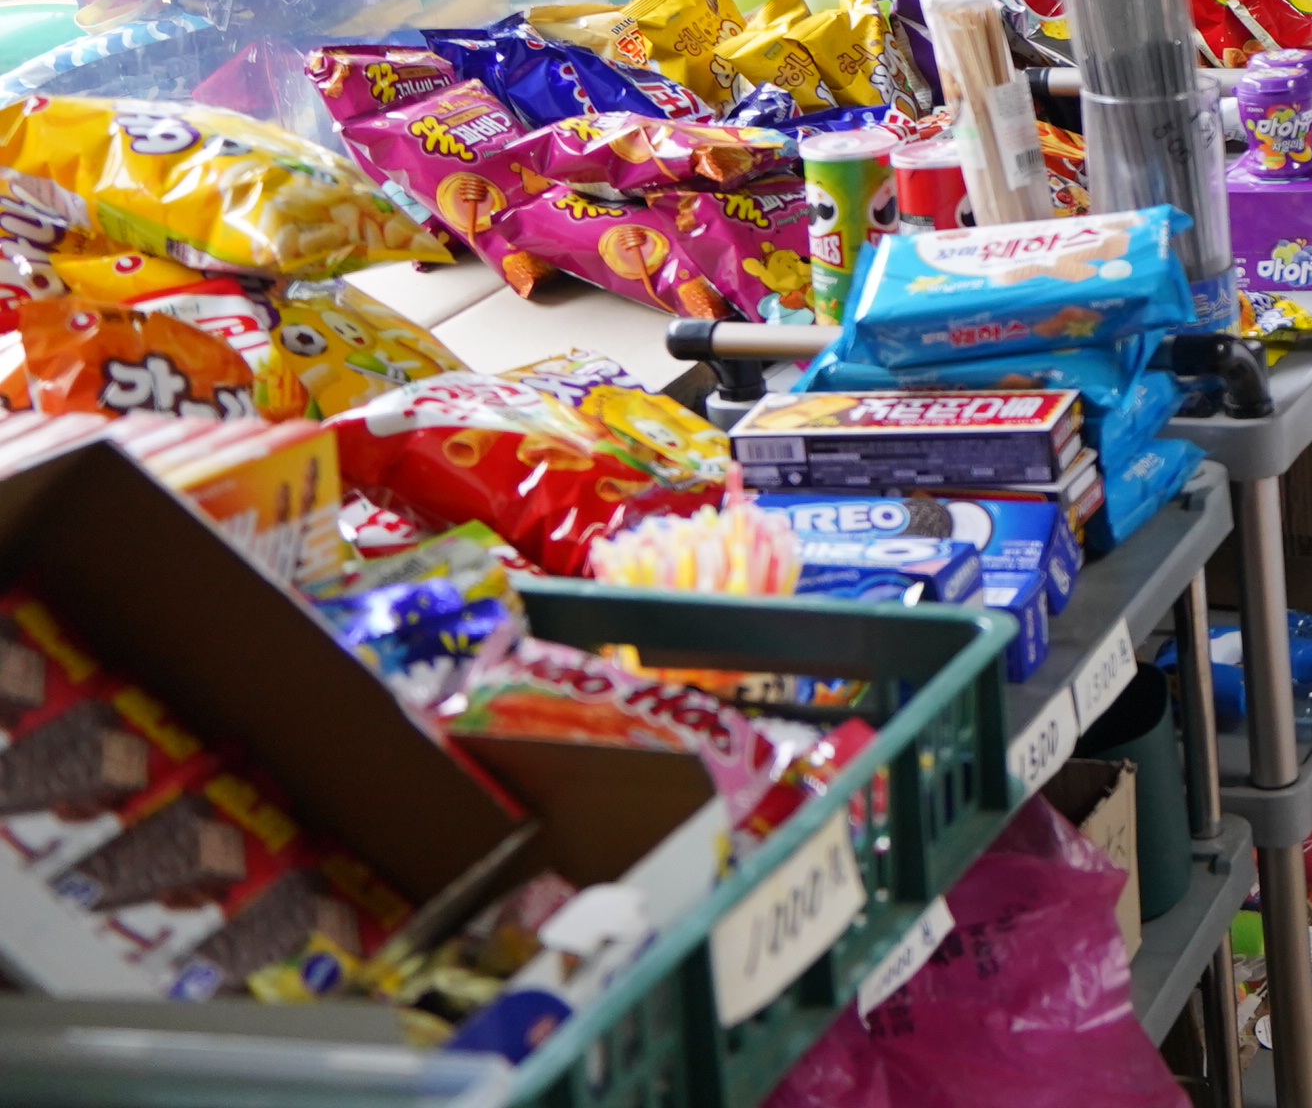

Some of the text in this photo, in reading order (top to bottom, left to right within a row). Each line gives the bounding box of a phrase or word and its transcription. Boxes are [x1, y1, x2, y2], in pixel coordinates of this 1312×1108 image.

[979, 228, 1101, 262] 웨하스
[947, 322, 1029, 346] 웨하스
[775, 504, 907, 532] REO
